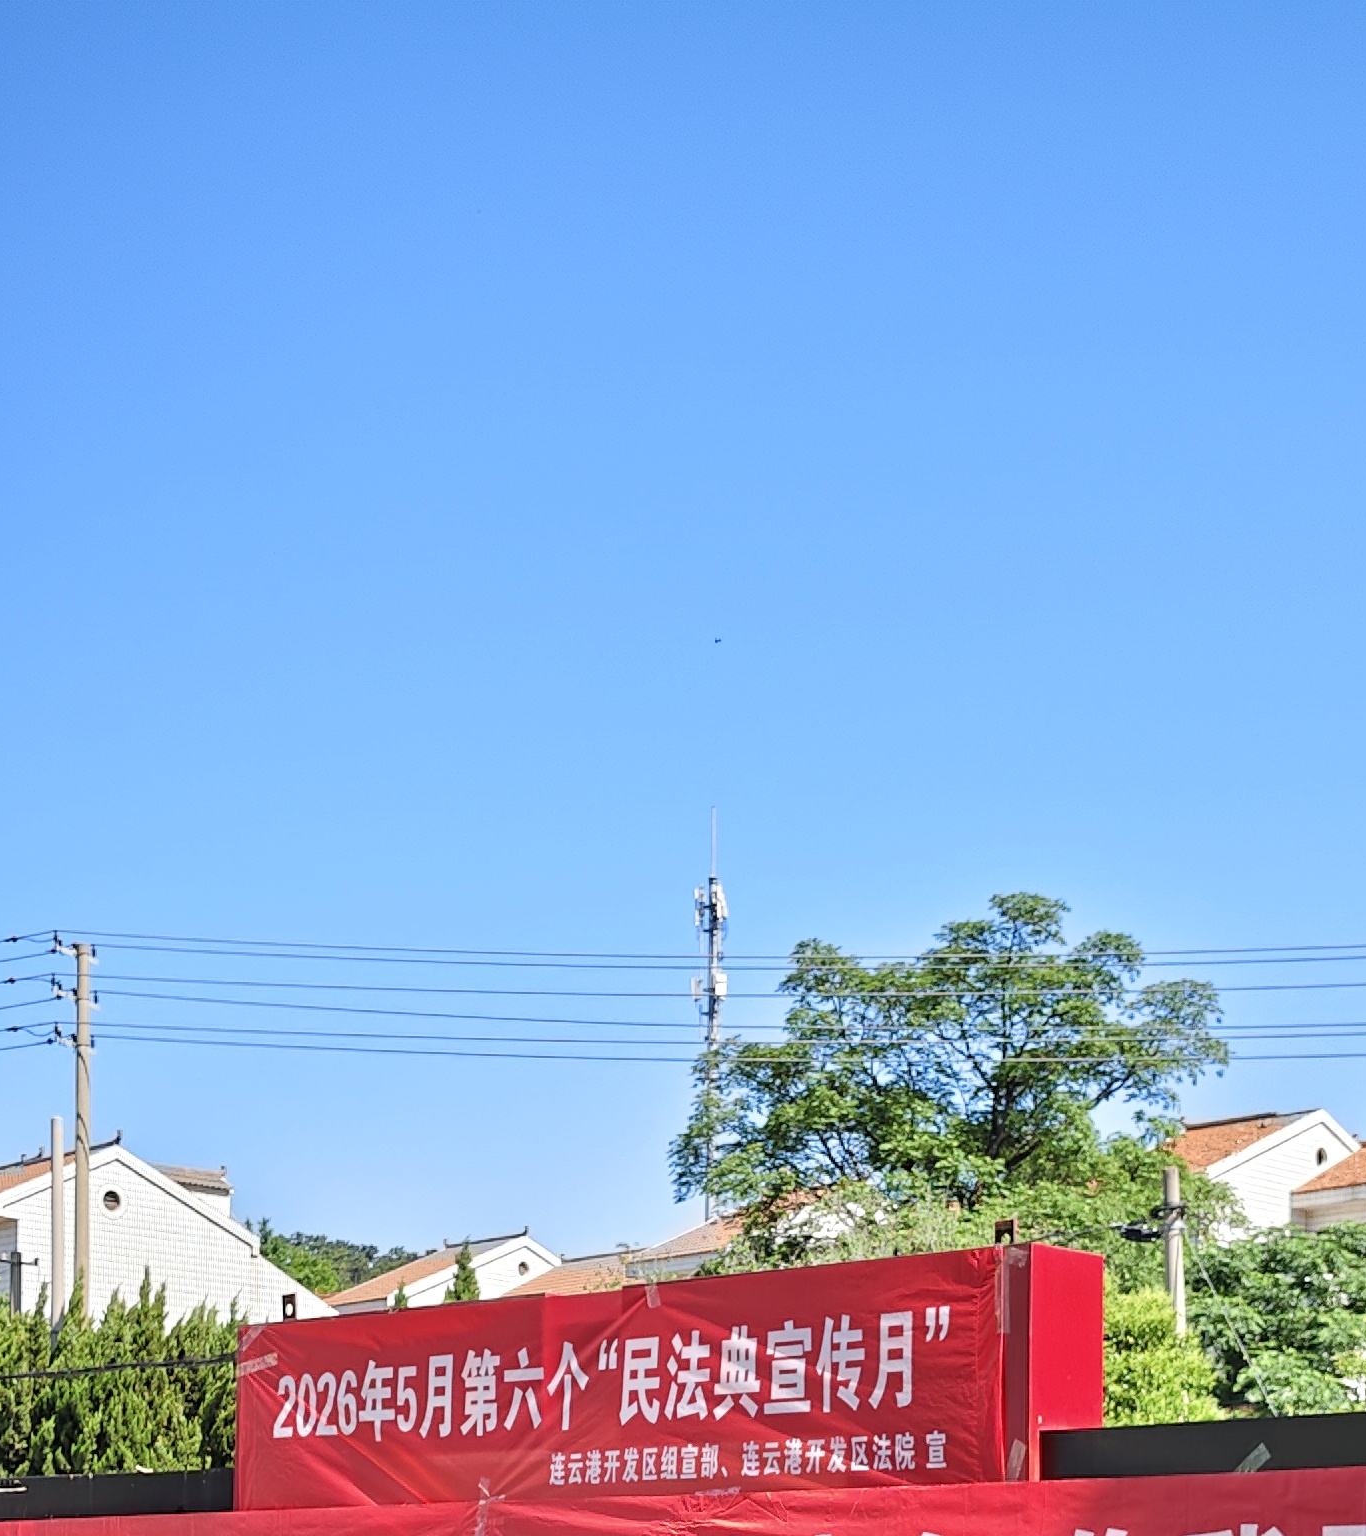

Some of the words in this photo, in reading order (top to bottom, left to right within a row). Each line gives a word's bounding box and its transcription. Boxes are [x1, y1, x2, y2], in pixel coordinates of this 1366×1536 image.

[272, 1305, 951, 1442] 2026年5月第六个“民法典宣传月”
[548, 1432, 917, 1487] 连云港开发区组宣部、连云港开发区法院
[925, 1430, 948, 1470] 宣
